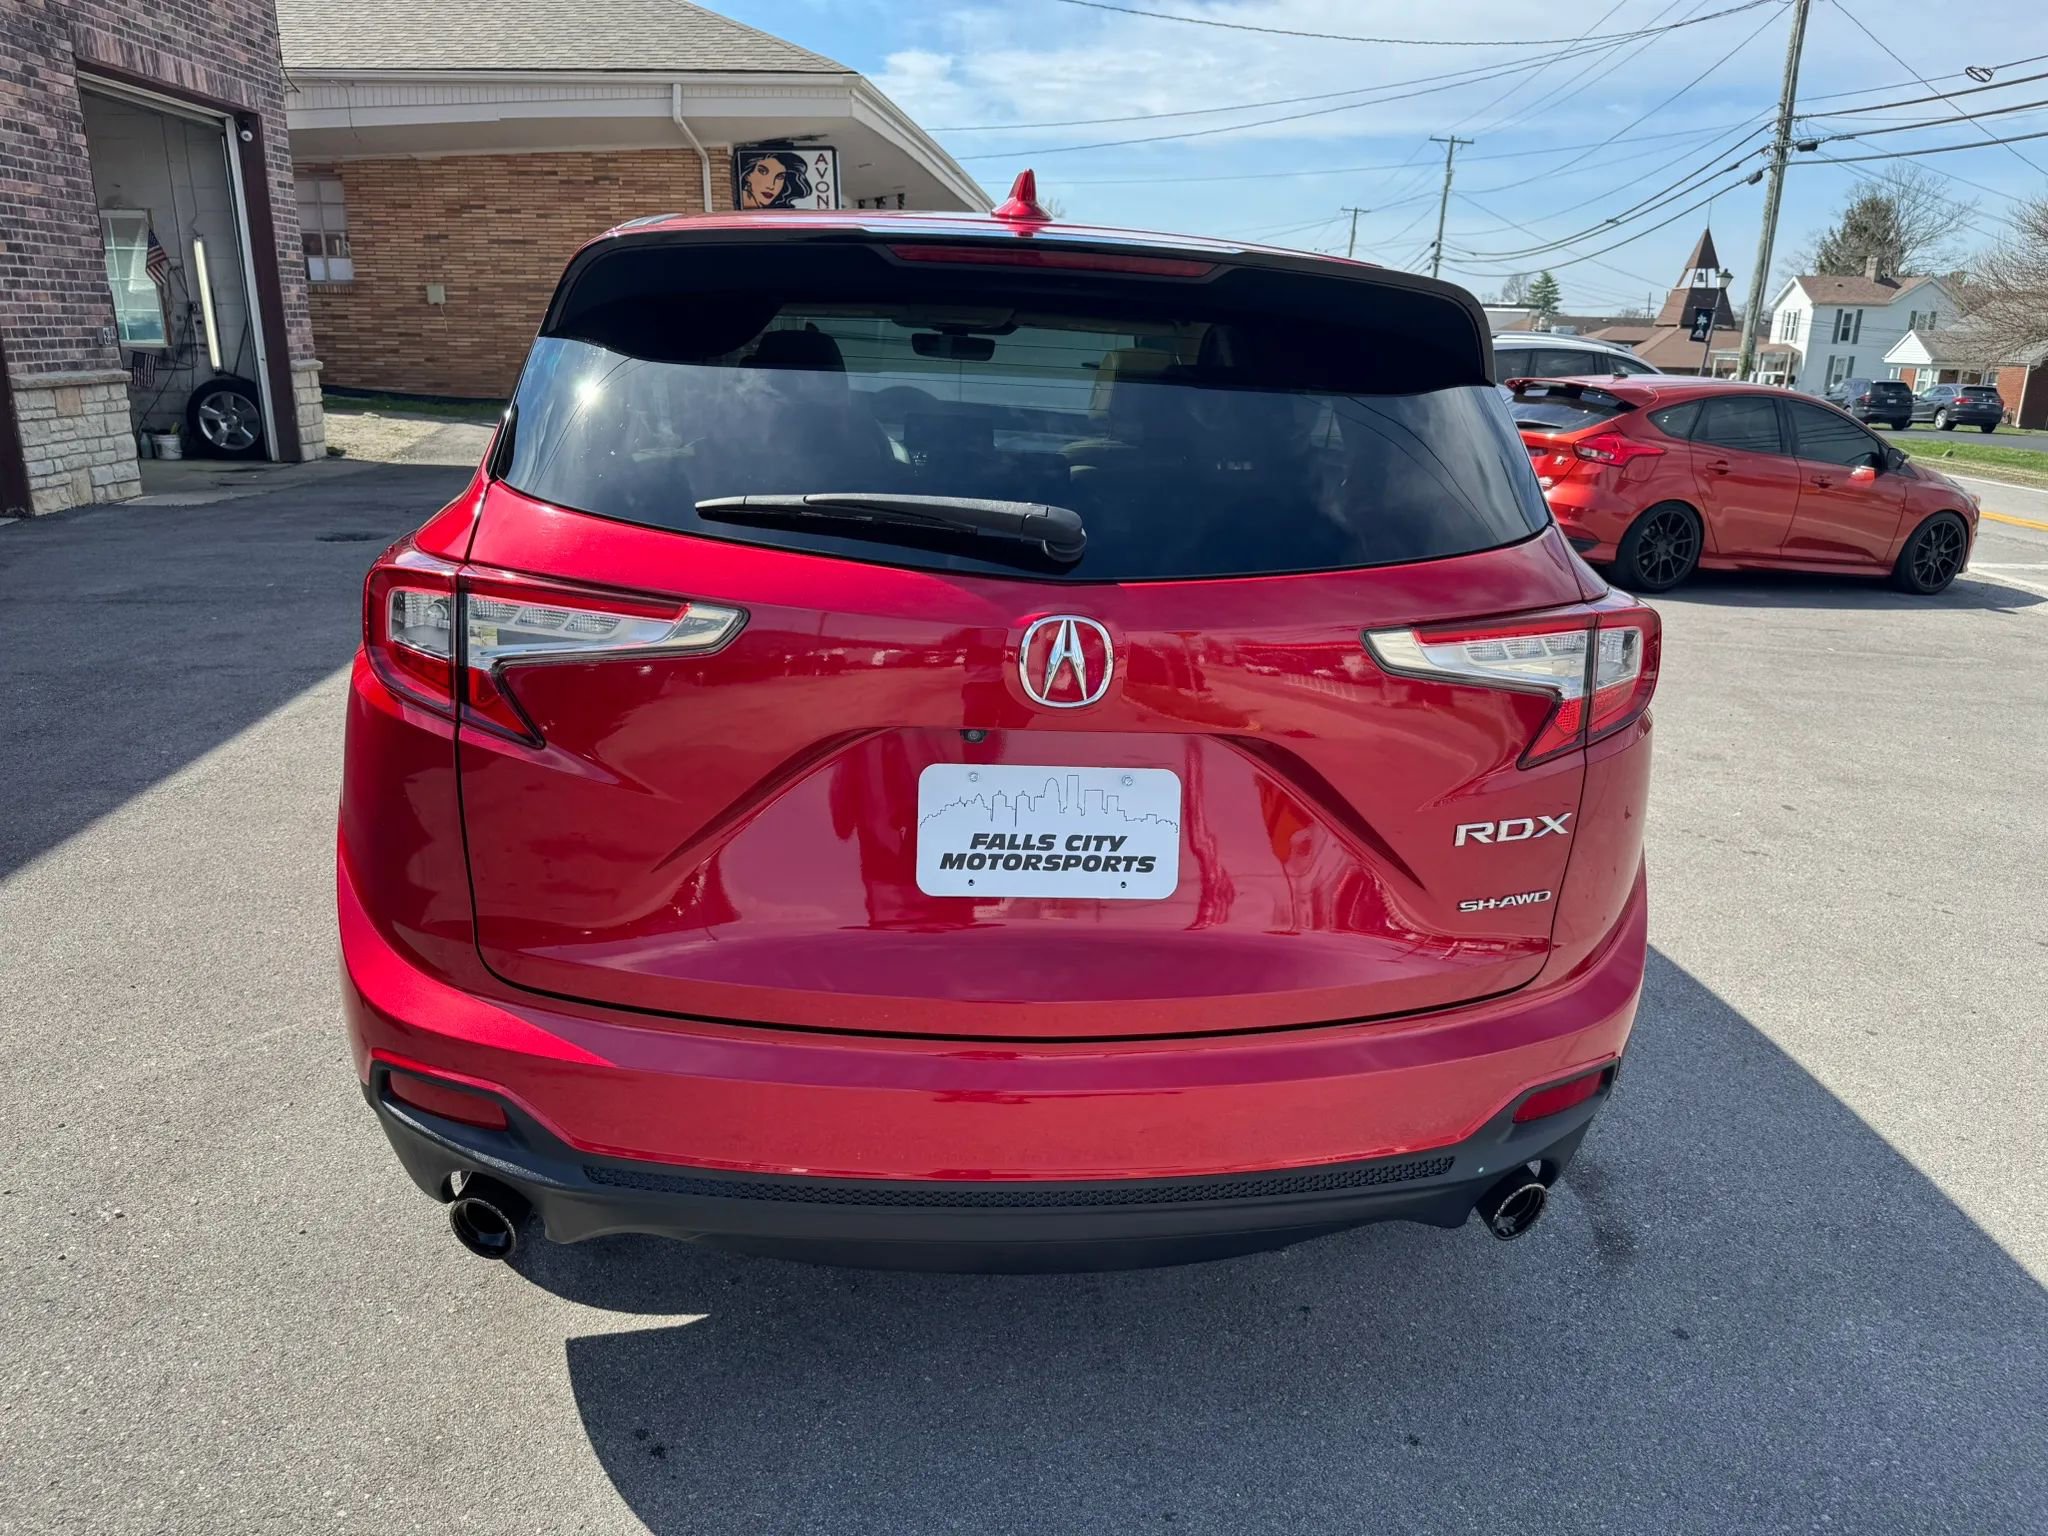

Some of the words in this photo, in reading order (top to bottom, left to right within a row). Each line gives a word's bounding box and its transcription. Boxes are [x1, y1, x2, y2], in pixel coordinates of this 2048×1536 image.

[814, 152, 830, 209] AVON
[1454, 812, 1573, 847] RDX
[969, 832, 1057, 851] FALLS
[1064, 834, 1128, 852] CITY
[939, 852, 1157, 873] MOTORSPORTS
[1459, 890, 1552, 912] SH-AWD
